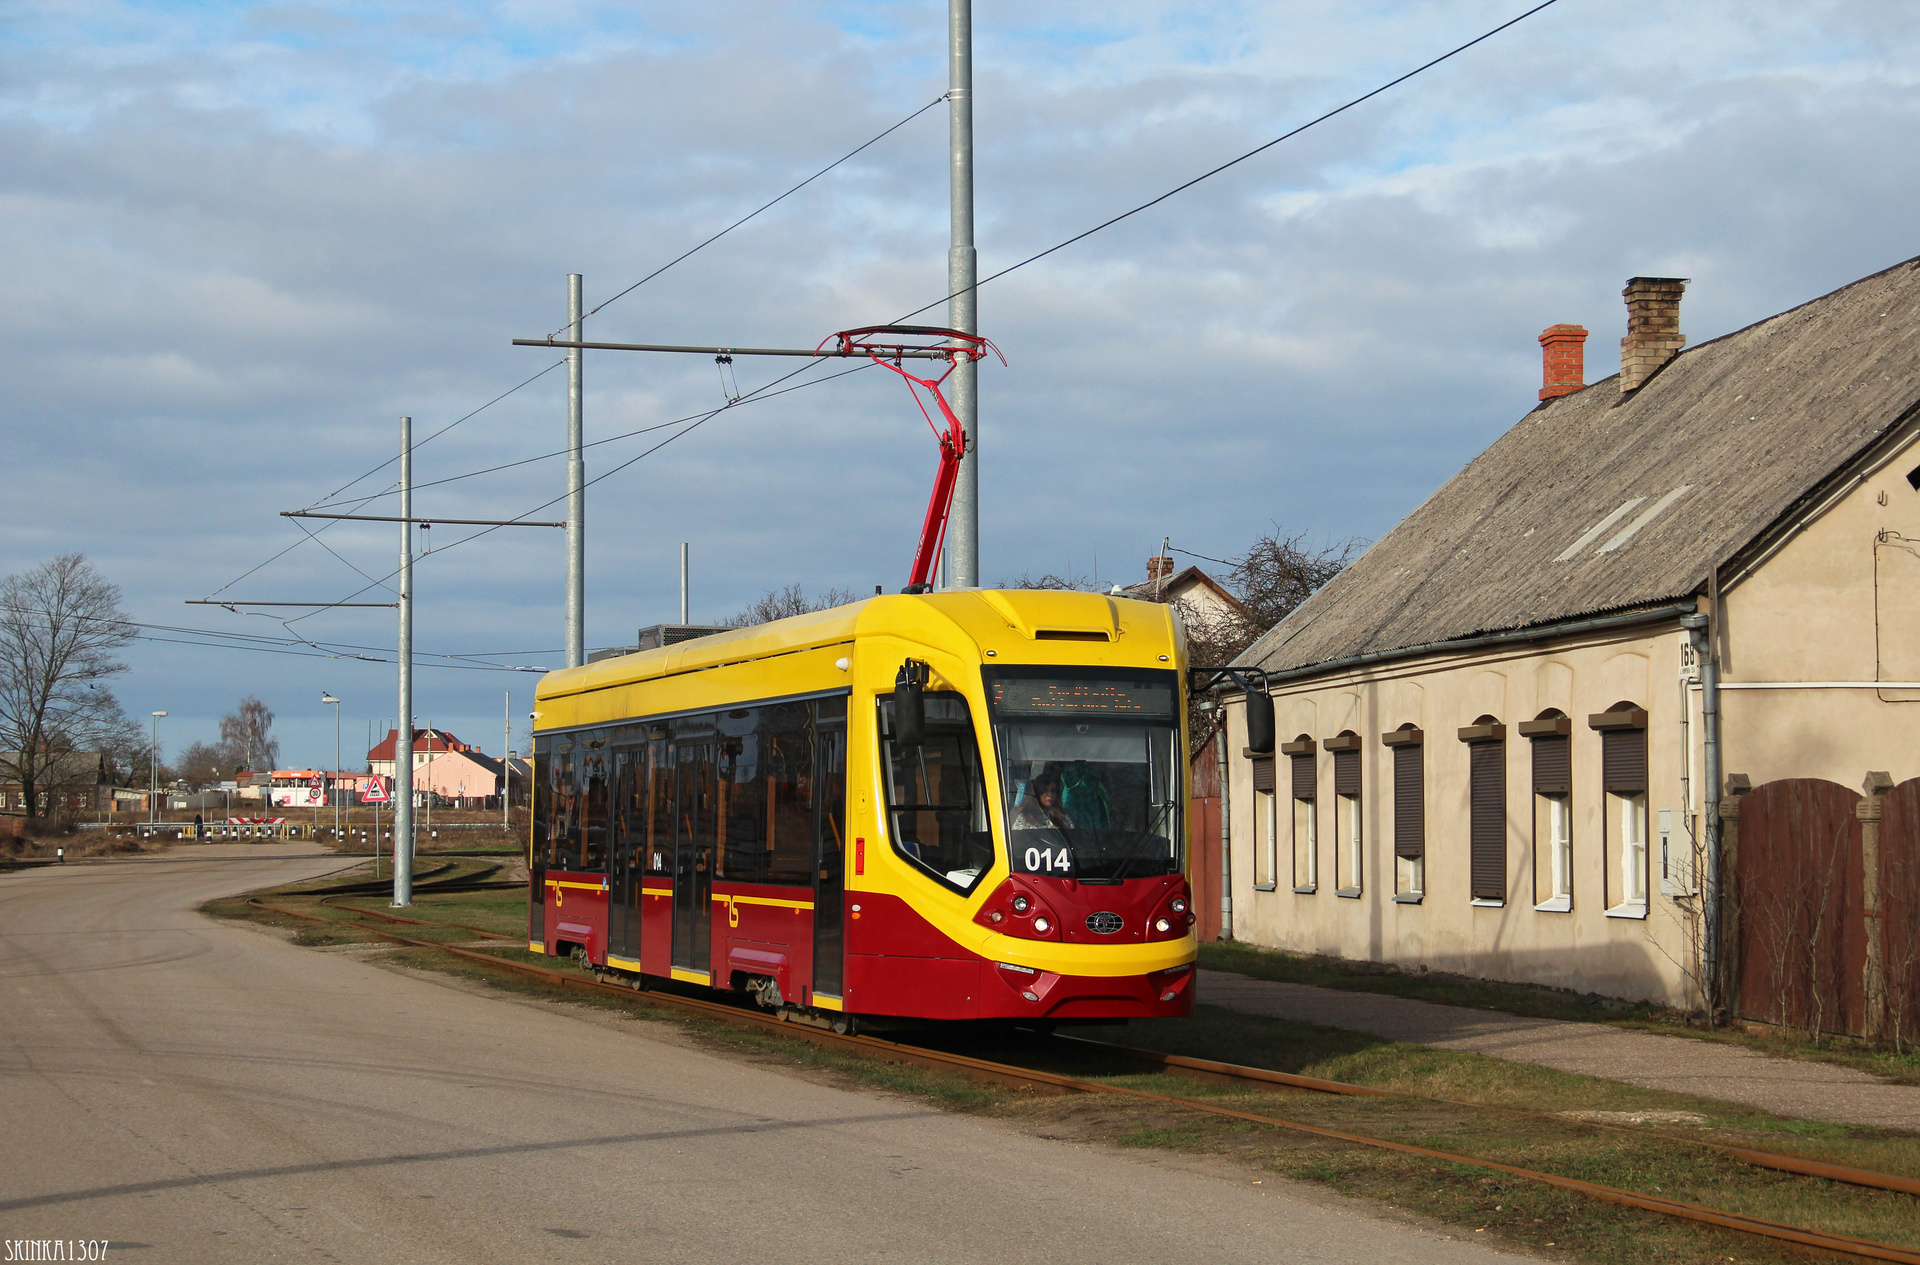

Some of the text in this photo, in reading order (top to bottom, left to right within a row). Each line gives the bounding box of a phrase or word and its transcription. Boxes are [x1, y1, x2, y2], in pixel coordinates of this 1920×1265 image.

[1681, 642, 1695, 667] 168
[653, 852, 662, 871] 014
[1024, 847, 1071, 872] 014
